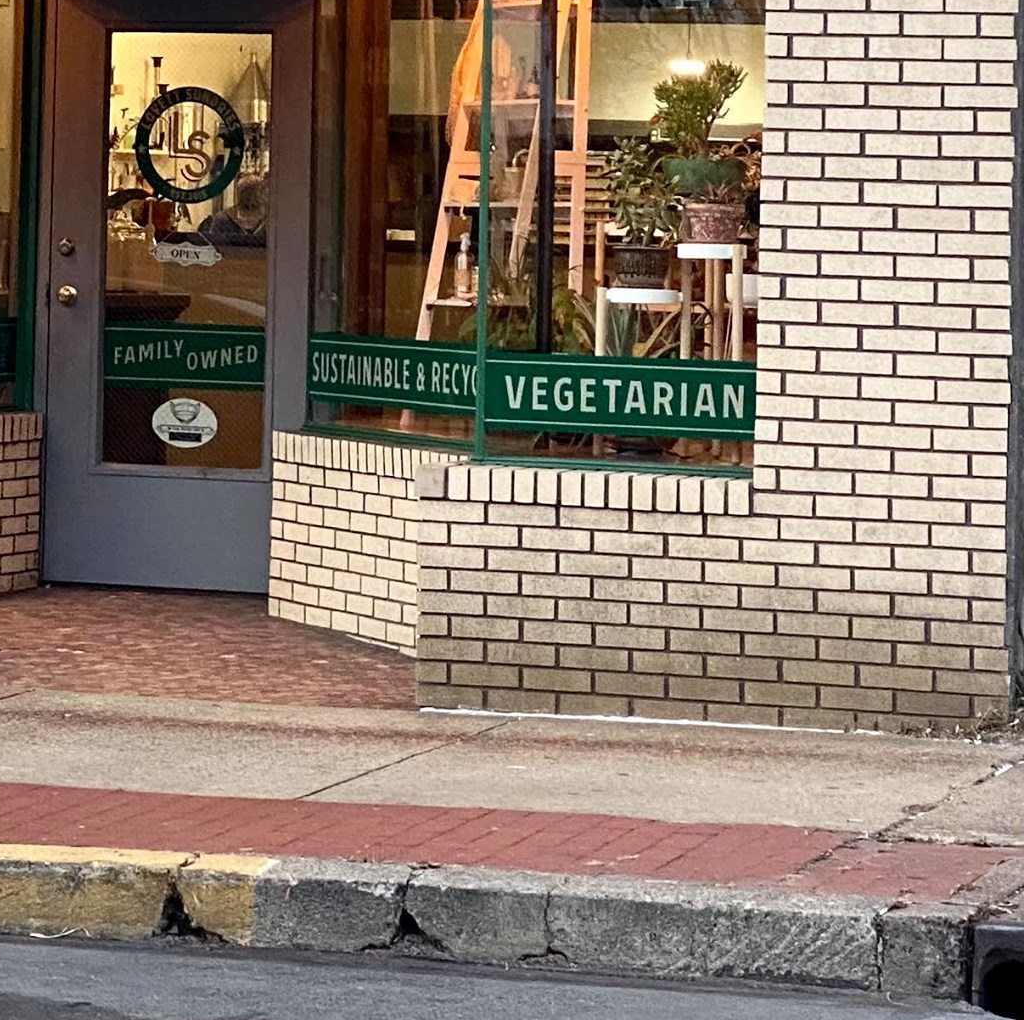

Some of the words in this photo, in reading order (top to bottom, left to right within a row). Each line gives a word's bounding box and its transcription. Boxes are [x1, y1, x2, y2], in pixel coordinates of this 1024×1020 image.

[171, 245, 201, 260] OPEN
[114, 339, 184, 365] FAMILY
[187, 344, 259, 370] OWNED
[312, 351, 410, 391] SUSTAINABLE
[416, 362, 426, 392] &
[505, 375, 745, 419] VEGETARIAN
